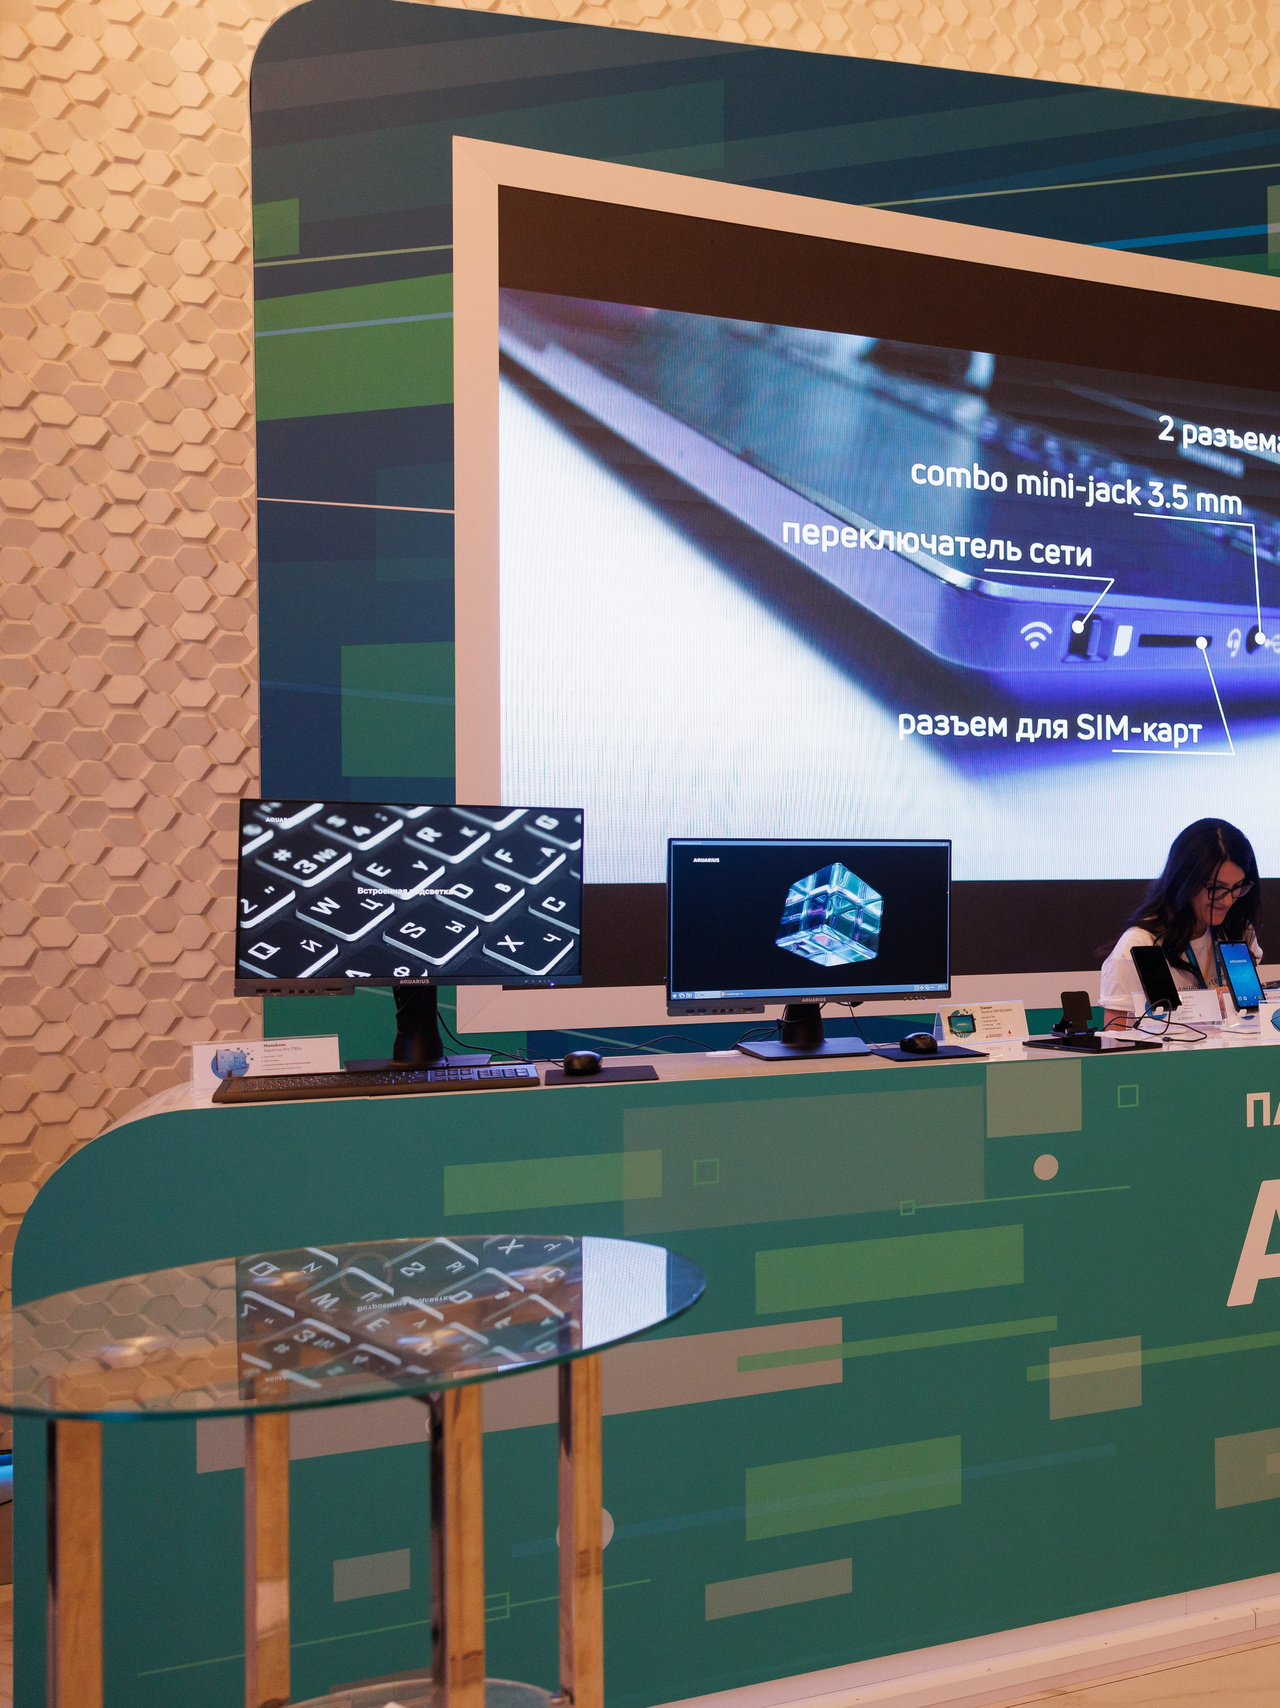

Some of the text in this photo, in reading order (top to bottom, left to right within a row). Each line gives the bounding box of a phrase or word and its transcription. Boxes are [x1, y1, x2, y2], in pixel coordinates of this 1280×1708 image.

[1158, 415, 1175, 442] 2
[910, 461, 1244, 516] combo mini-jack 3.5 mm
[781, 520, 1093, 568] переключатель сети
[899, 711, 1202, 749] разъем для SIM-карт
[357, 887, 455, 897] Встроенная дсветка
